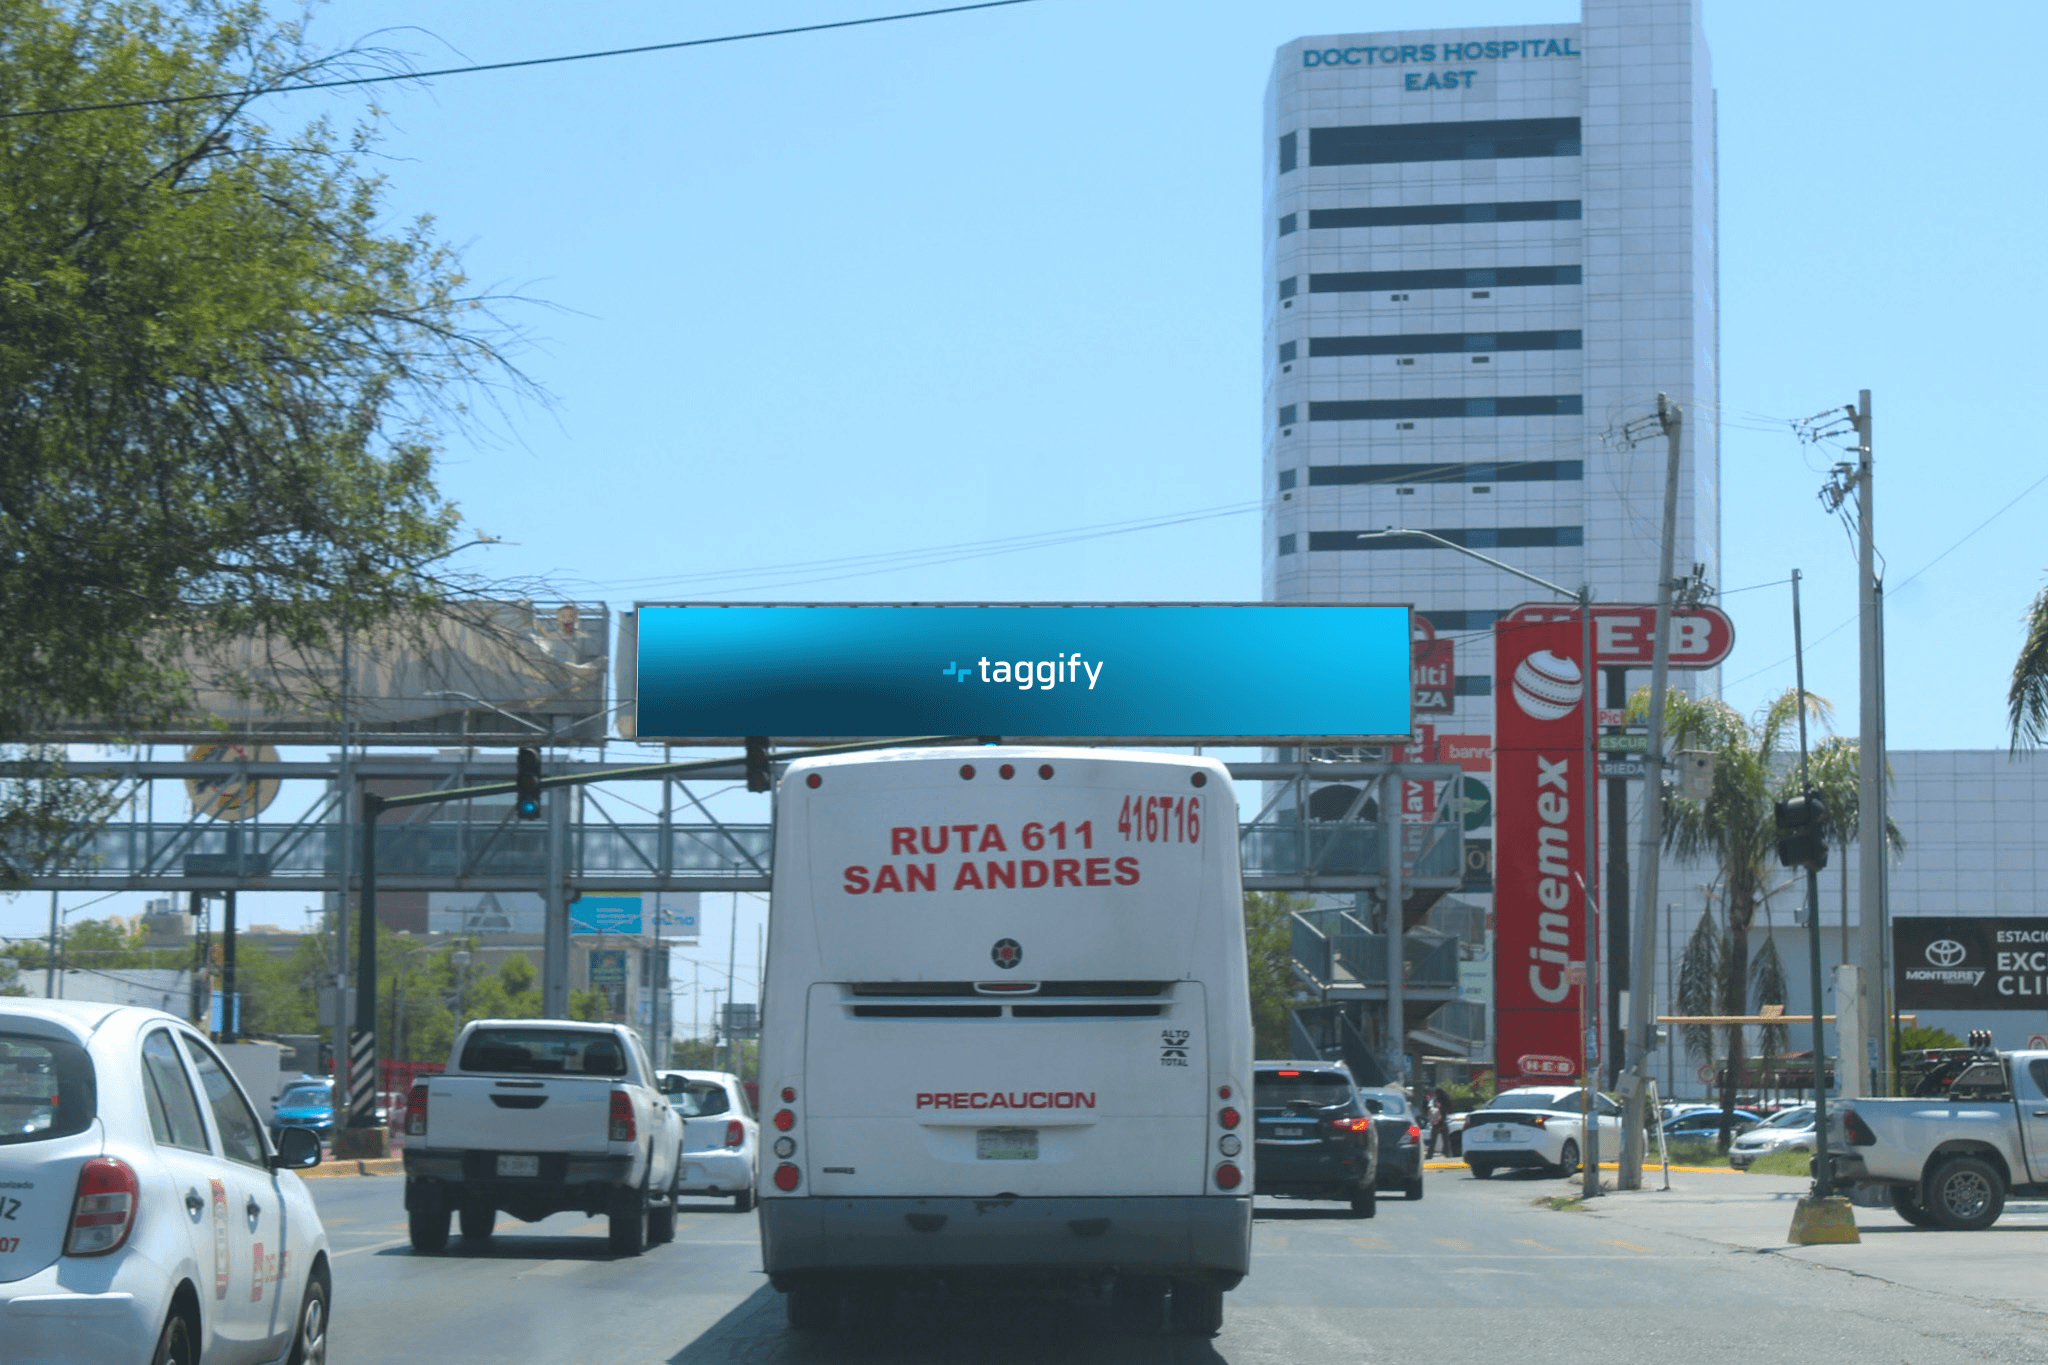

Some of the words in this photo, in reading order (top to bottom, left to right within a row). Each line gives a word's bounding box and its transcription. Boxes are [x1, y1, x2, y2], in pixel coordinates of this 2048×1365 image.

[1303, 44, 1437, 68] DOCTORS
[1443, 38, 1581, 61] HOSPITAL
[1404, 70, 1478, 91] EAST
[978, 653, 1103, 690] taggify
[1118, 795, 1200, 844] 416T16
[891, 823, 1007, 855] RUTA
[1021, 821, 1092, 851] 611
[843, 863, 936, 894] SAN
[953, 857, 1140, 891] ANDRES
[1528, 755, 1570, 1003] Cinemex
[1998, 952, 2048, 971] EXC
[1906, 970, 1985, 987] MONTERREY
[1998, 975, 2048, 996] CLI
[1161, 1030, 1190, 1038] ALTO
[1160, 1058, 1188, 1067] TOTAL
[916, 1091, 1096, 1110] PRECAUCION
